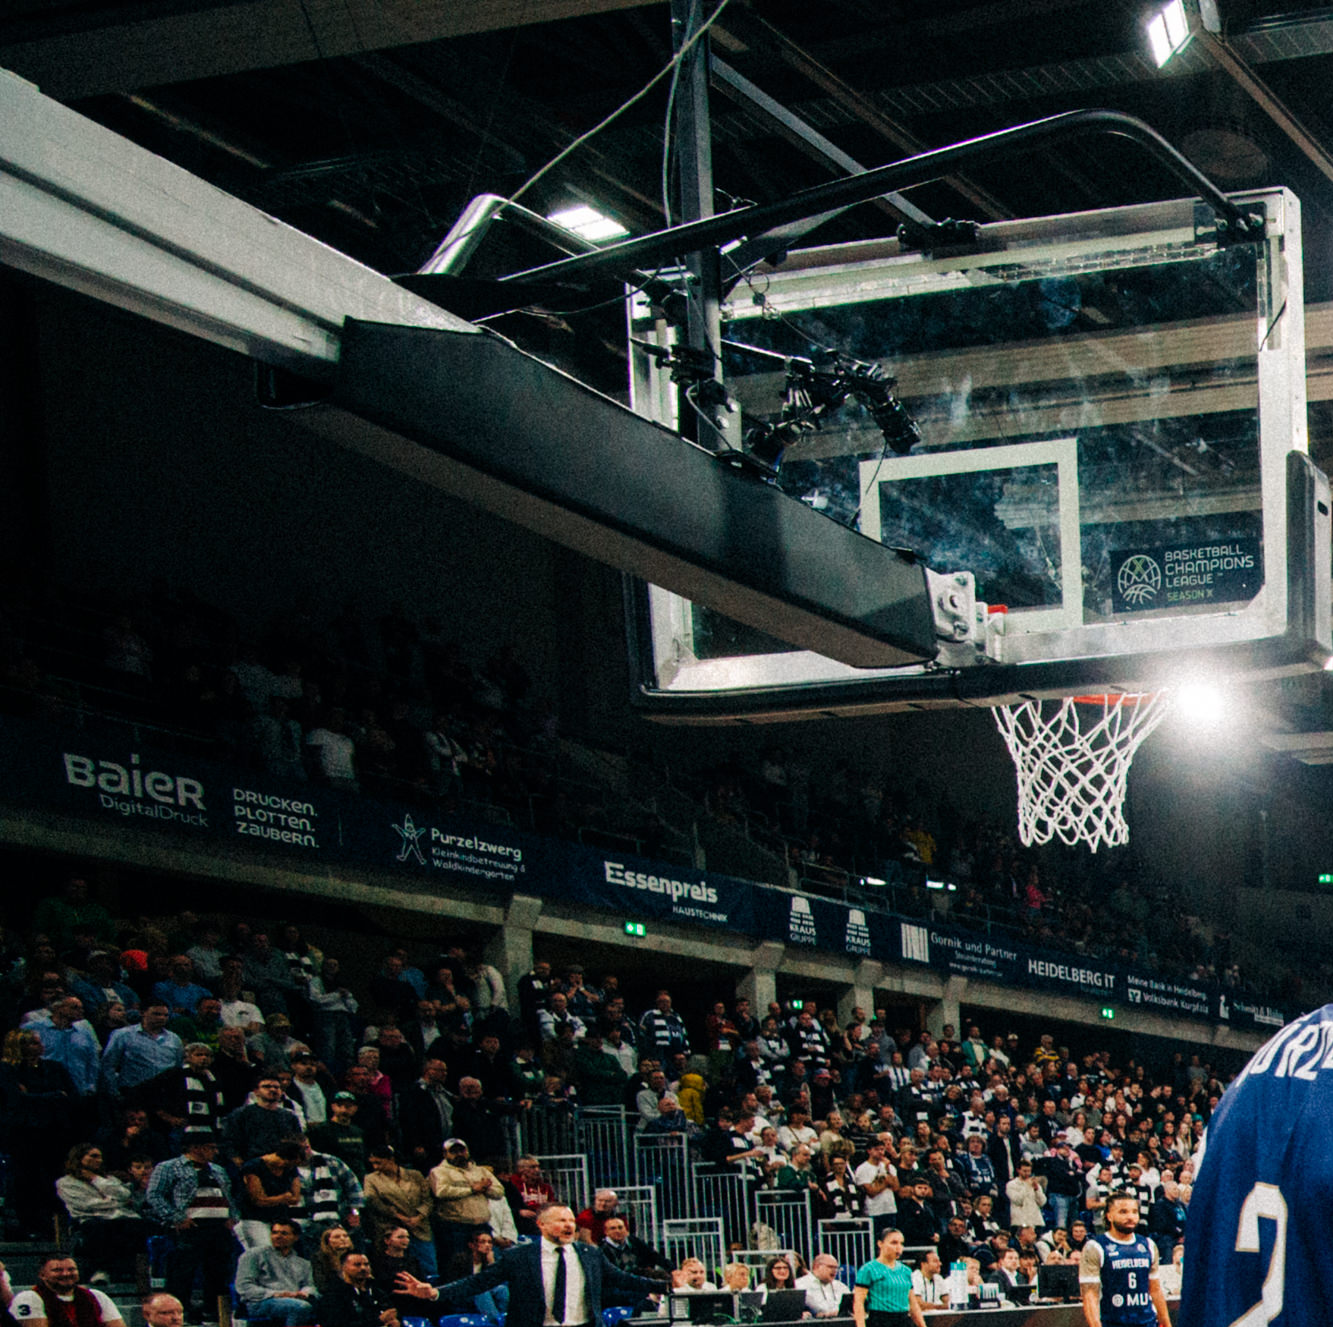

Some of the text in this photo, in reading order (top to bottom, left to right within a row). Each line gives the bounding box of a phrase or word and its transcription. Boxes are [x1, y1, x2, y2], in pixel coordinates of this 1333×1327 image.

[1165, 544, 1244, 561] BASKETBALL
[1165, 555, 1255, 576] CHAMPIONS
[1166, 573, 1214, 588] LEAGUE
[1168, 588, 1214, 601] SEASON X
[100, 794, 209, 827] DigitalDruck
[431, 828, 522, 862] Purzelzwerg
[432, 858, 516, 881] Waldkindergarten
[604, 860, 719, 904] Essenpreis
[672, 905, 729, 923] HAUSTECHNIK
[789, 923, 817, 936] KRAUS
[845, 935, 871, 948] KRAUS
[930, 931, 1018, 961] Gornik und Partner
[1028, 959, 1102, 986] HEIDELBERG
[1127, 974, 1149, 988] Meine
[1150, 979, 1166, 990] Bank
[1142, 992, 1179, 1008] Volksbank
[1128, 1272, 1137, 1289] 6
[17, 1304, 33, 1316] 3
